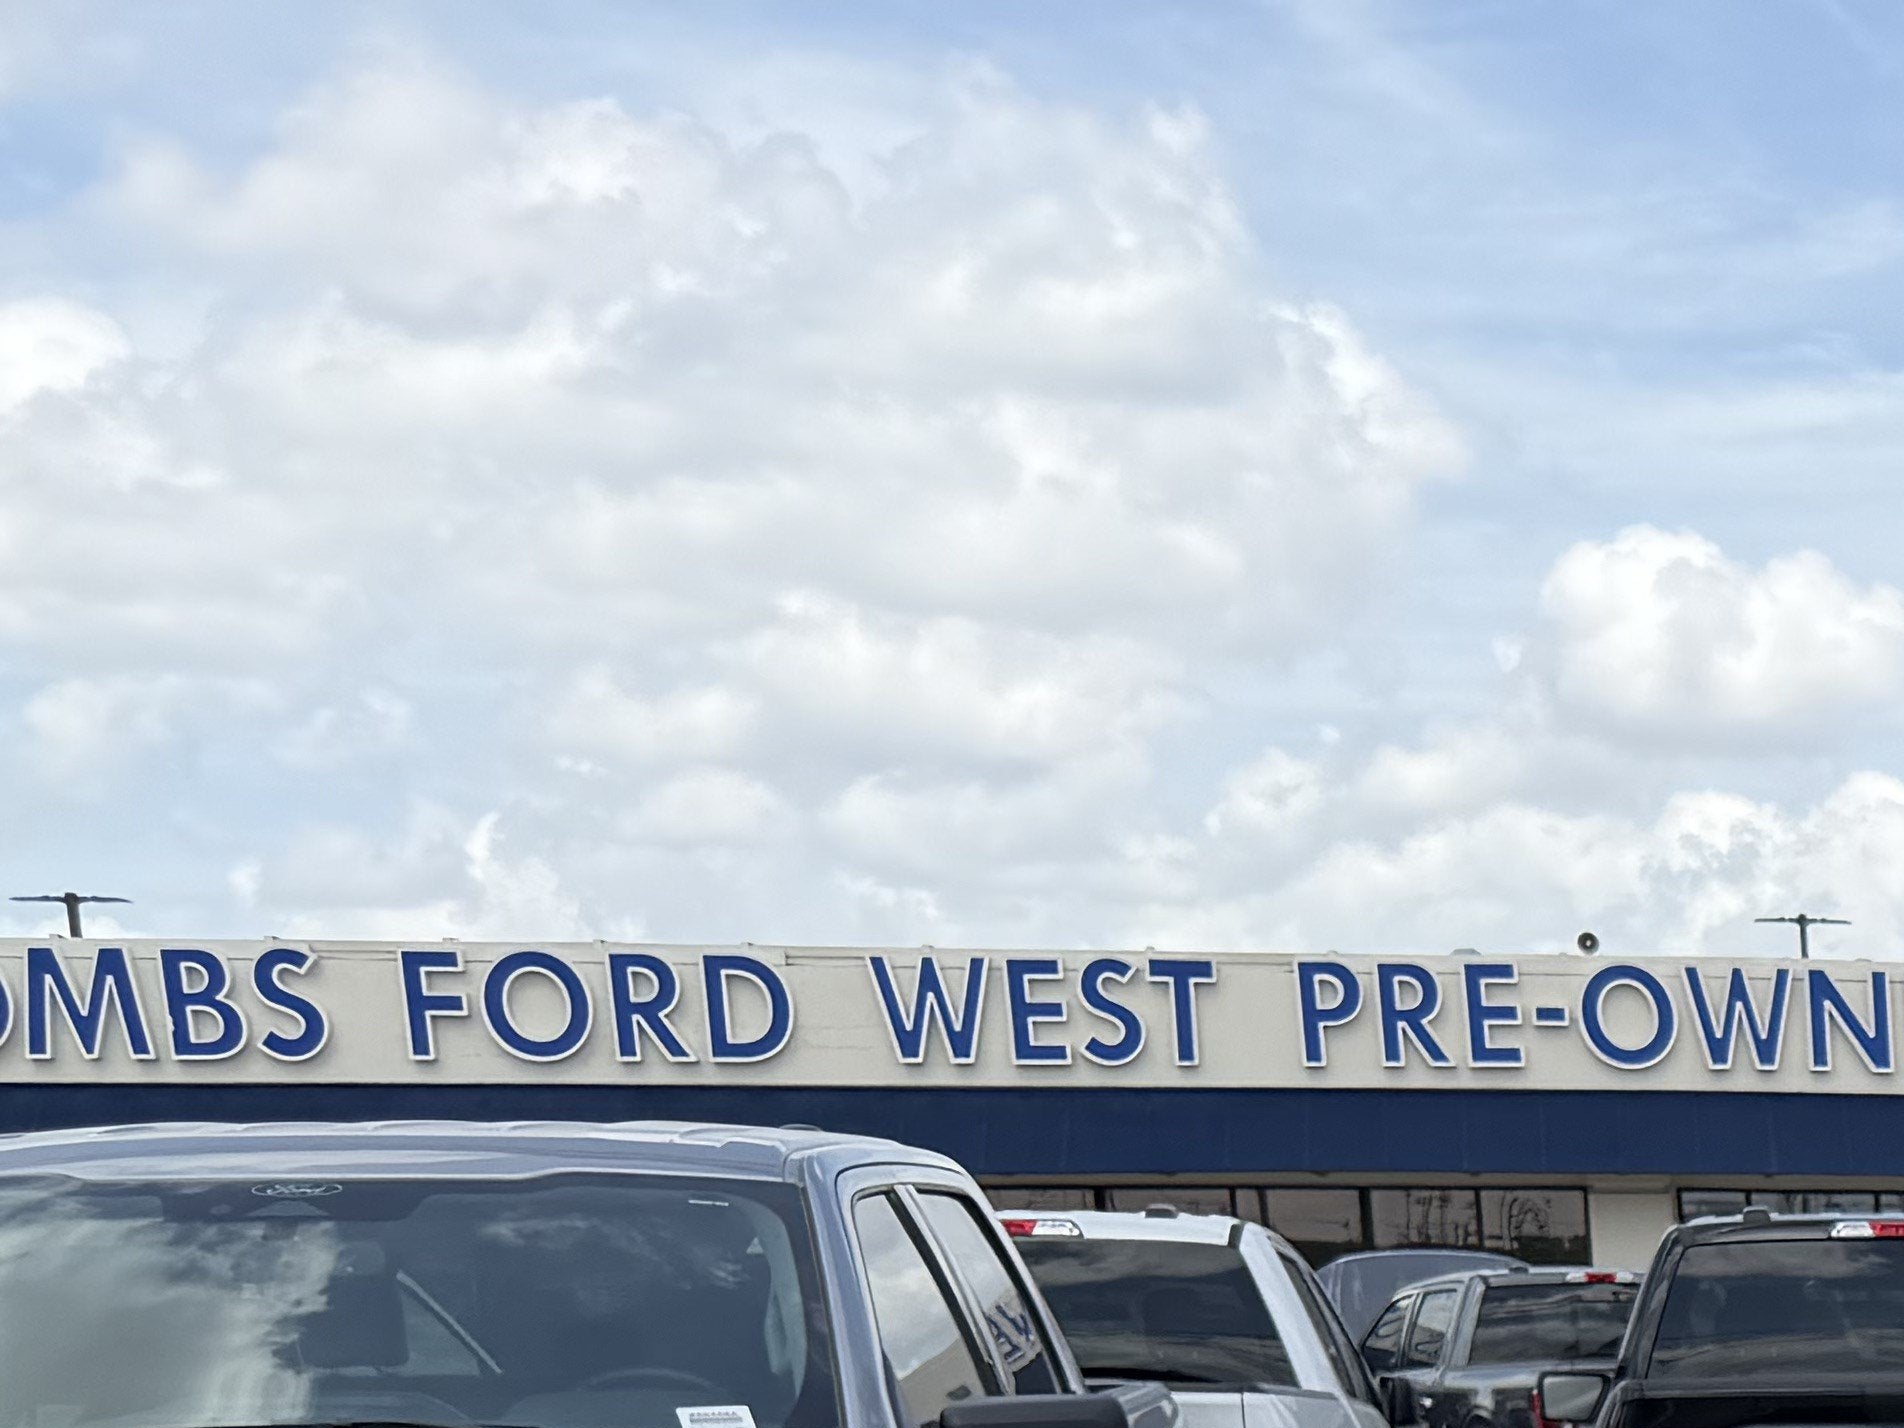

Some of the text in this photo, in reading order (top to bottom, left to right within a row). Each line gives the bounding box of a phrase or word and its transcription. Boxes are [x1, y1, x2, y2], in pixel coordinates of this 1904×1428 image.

[0, 947, 330, 1061] MBS
[398, 949, 794, 1063] FORD
[868, 955, 1216, 1066] WEST
